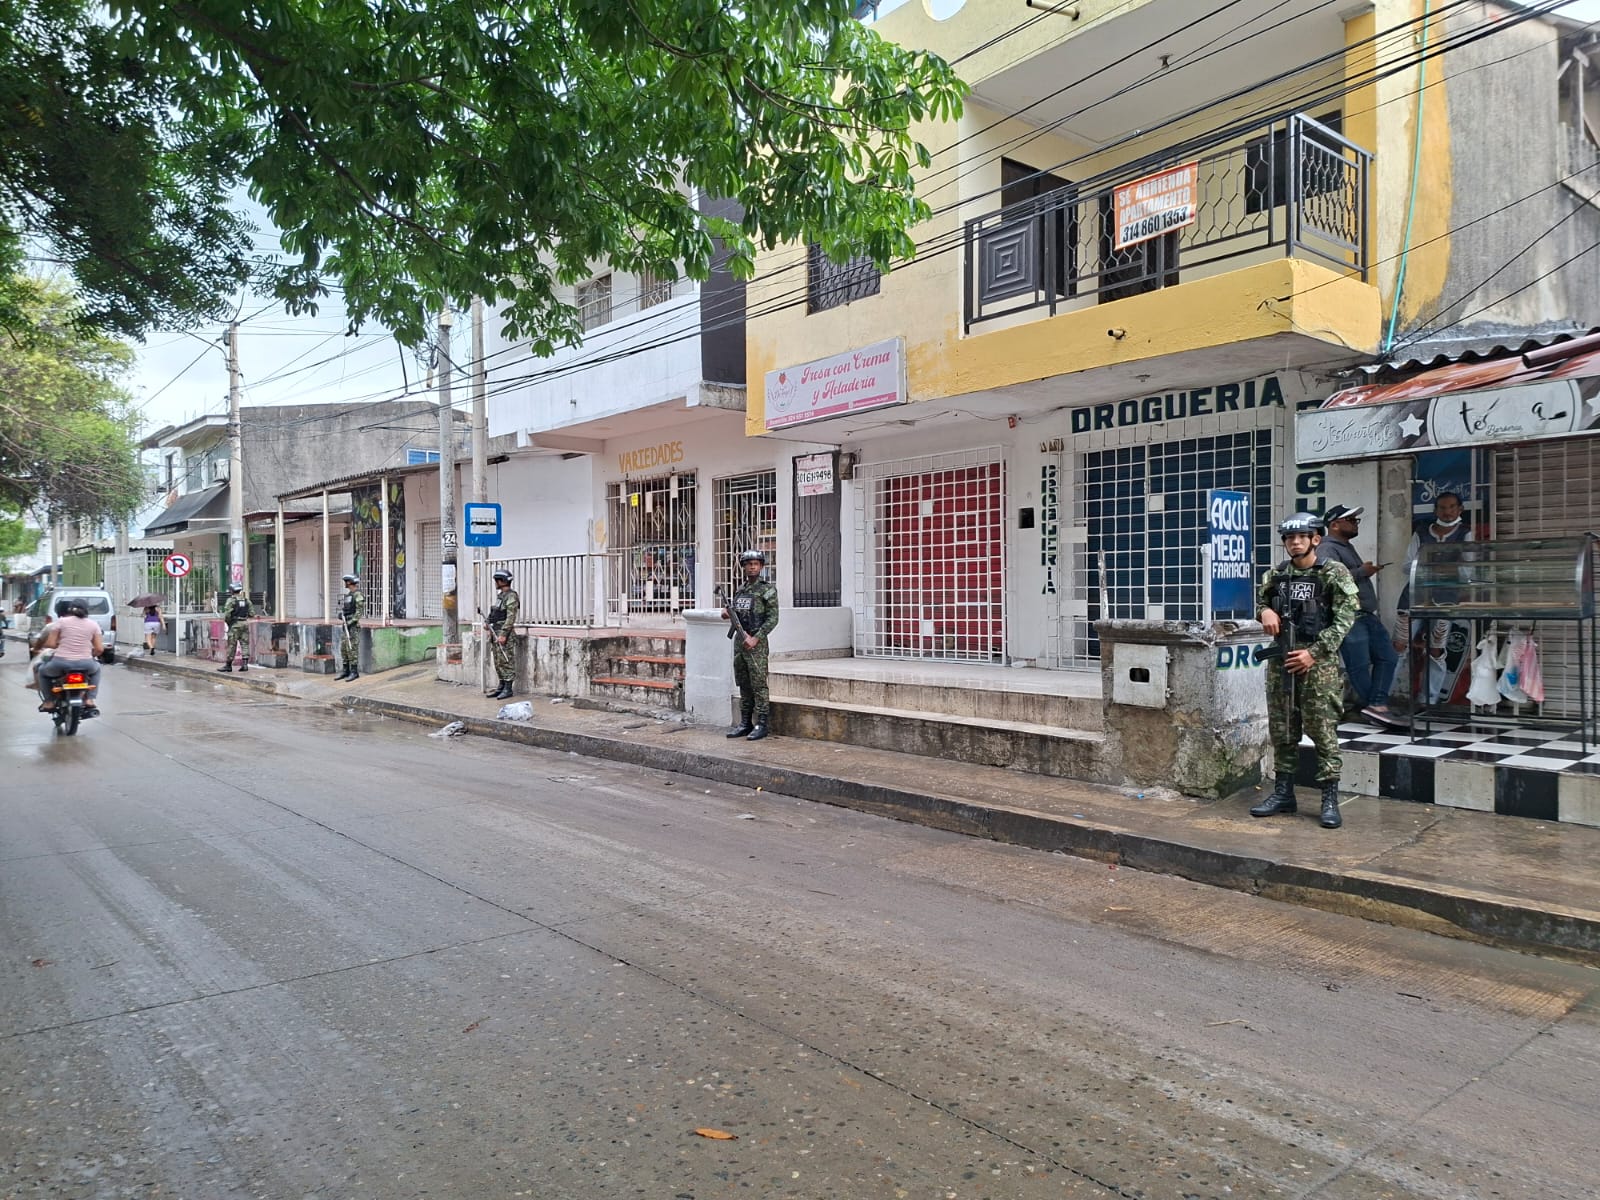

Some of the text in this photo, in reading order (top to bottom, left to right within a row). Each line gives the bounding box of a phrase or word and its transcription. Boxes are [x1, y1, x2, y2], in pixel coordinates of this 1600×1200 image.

[1119, 188, 1131, 207] SE
[1120, 187, 1190, 225] APARTAMENTO
[1122, 206, 1188, 242] 314 860 1353
[832, 362, 851, 376] con
[853, 351, 891, 369] Crema
[811, 388, 820, 406] y
[1071, 376, 1285, 433] DROGUERIA
[619, 441, 684, 473] VARIEDADES
[1211, 496, 1248, 531] AQUÍ
[445, 533, 457, 544] 24
[1212, 534, 1245, 561] MEGA
[1213, 562, 1250, 578] FARMACIA
